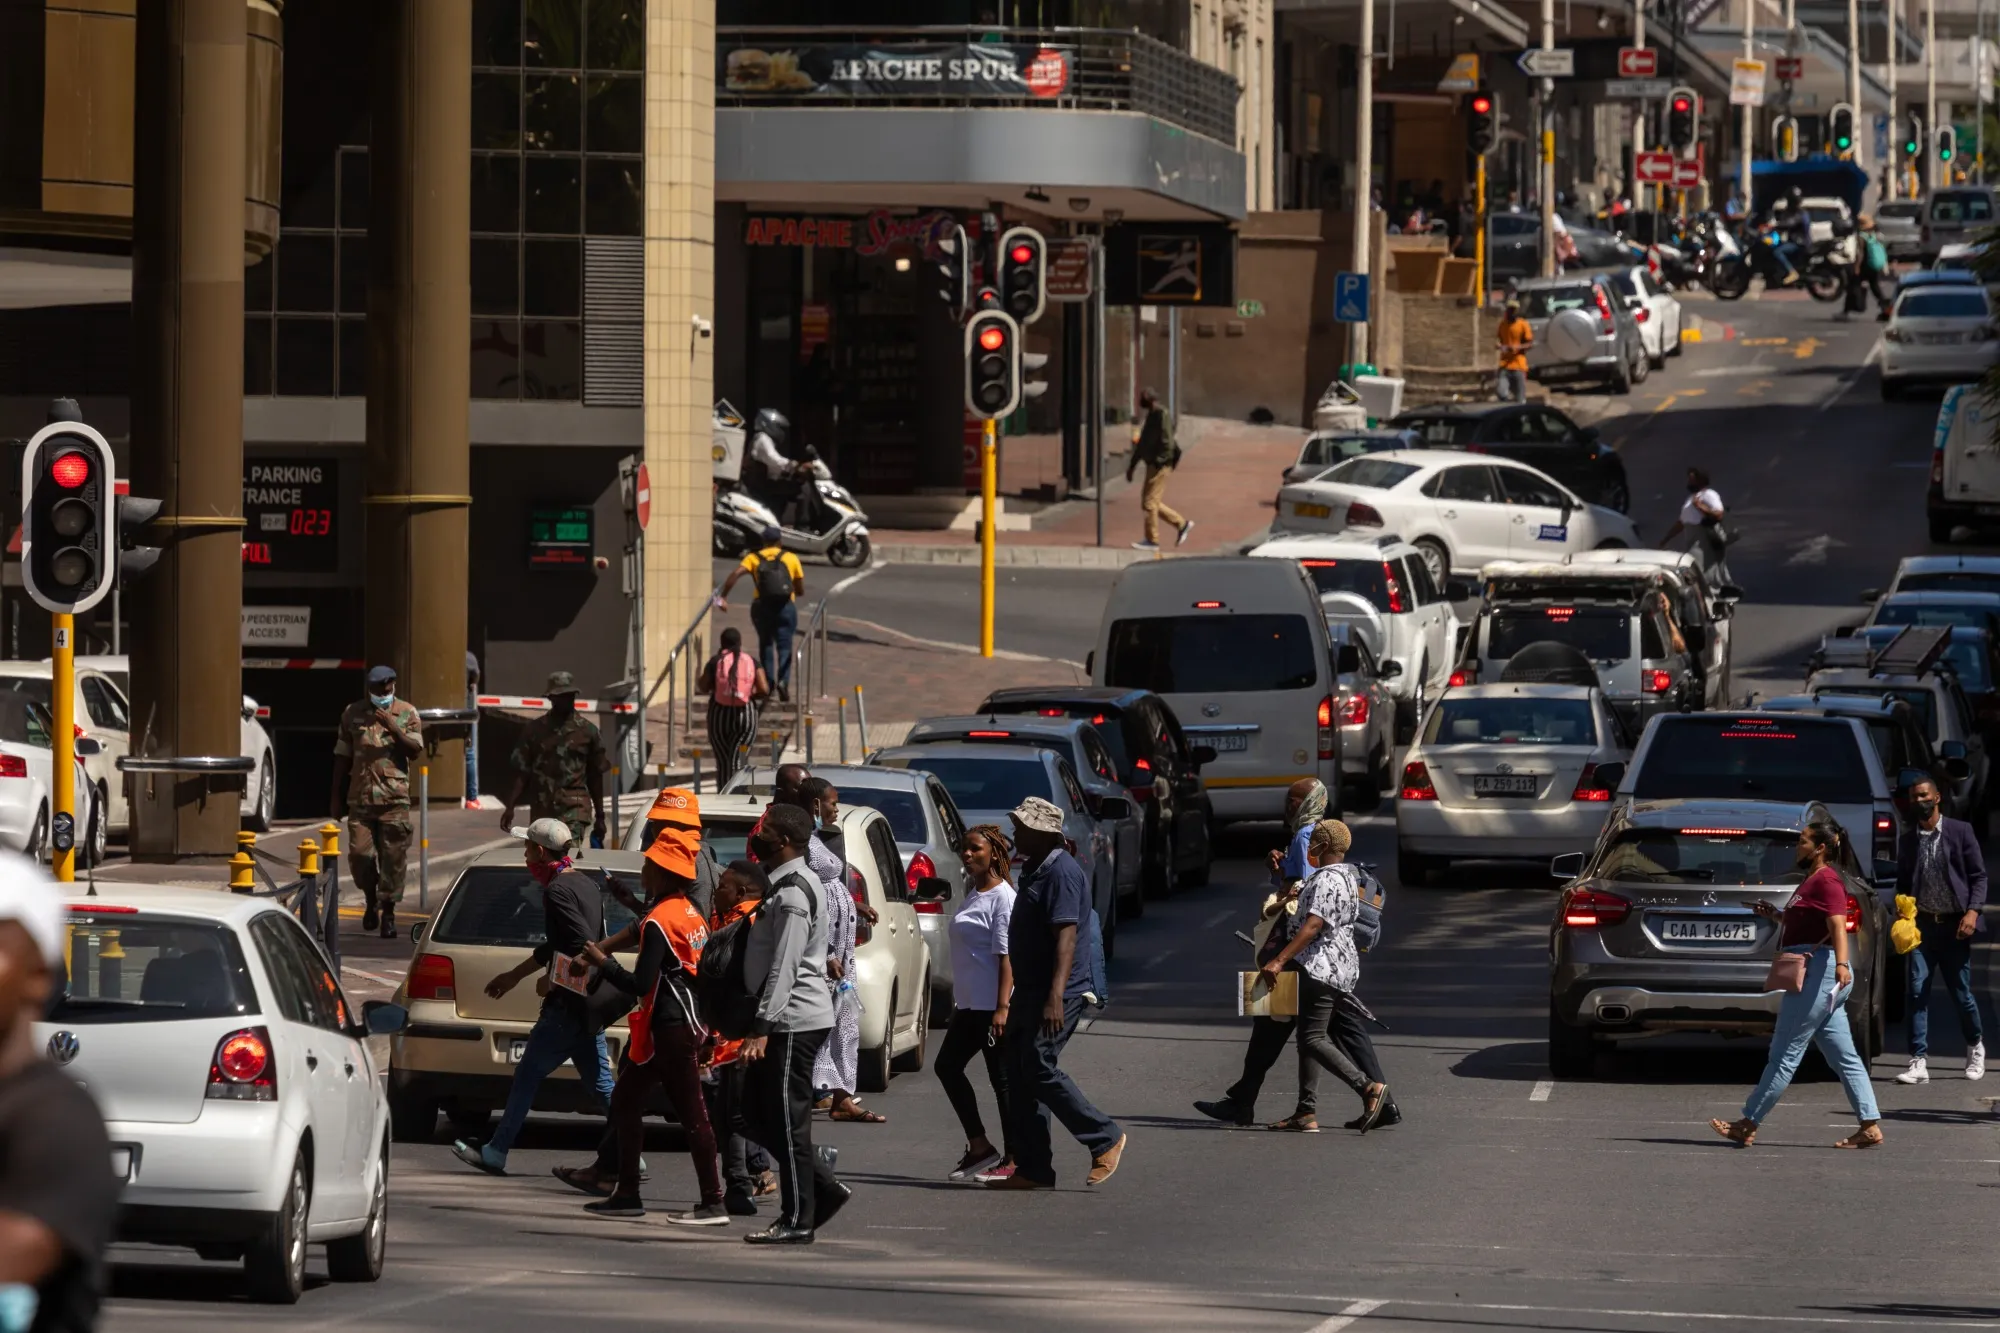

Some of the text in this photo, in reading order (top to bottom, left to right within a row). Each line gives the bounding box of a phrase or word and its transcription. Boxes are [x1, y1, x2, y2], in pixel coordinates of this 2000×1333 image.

[830, 59, 942, 81] APACHE
[949, 59, 1017, 83] SPUR
[746, 218, 851, 247] APACHE
[1343, 277, 1360, 296] P
[251, 466, 322, 483] PARKING
[290, 509, 331, 535] 023
[247, 614, 307, 625] PEDESTRIAN
[57, 630, 65, 646] 4
[248, 628, 287, 639] ACCESS
[1670, 923, 1750, 939] CAA 16675
